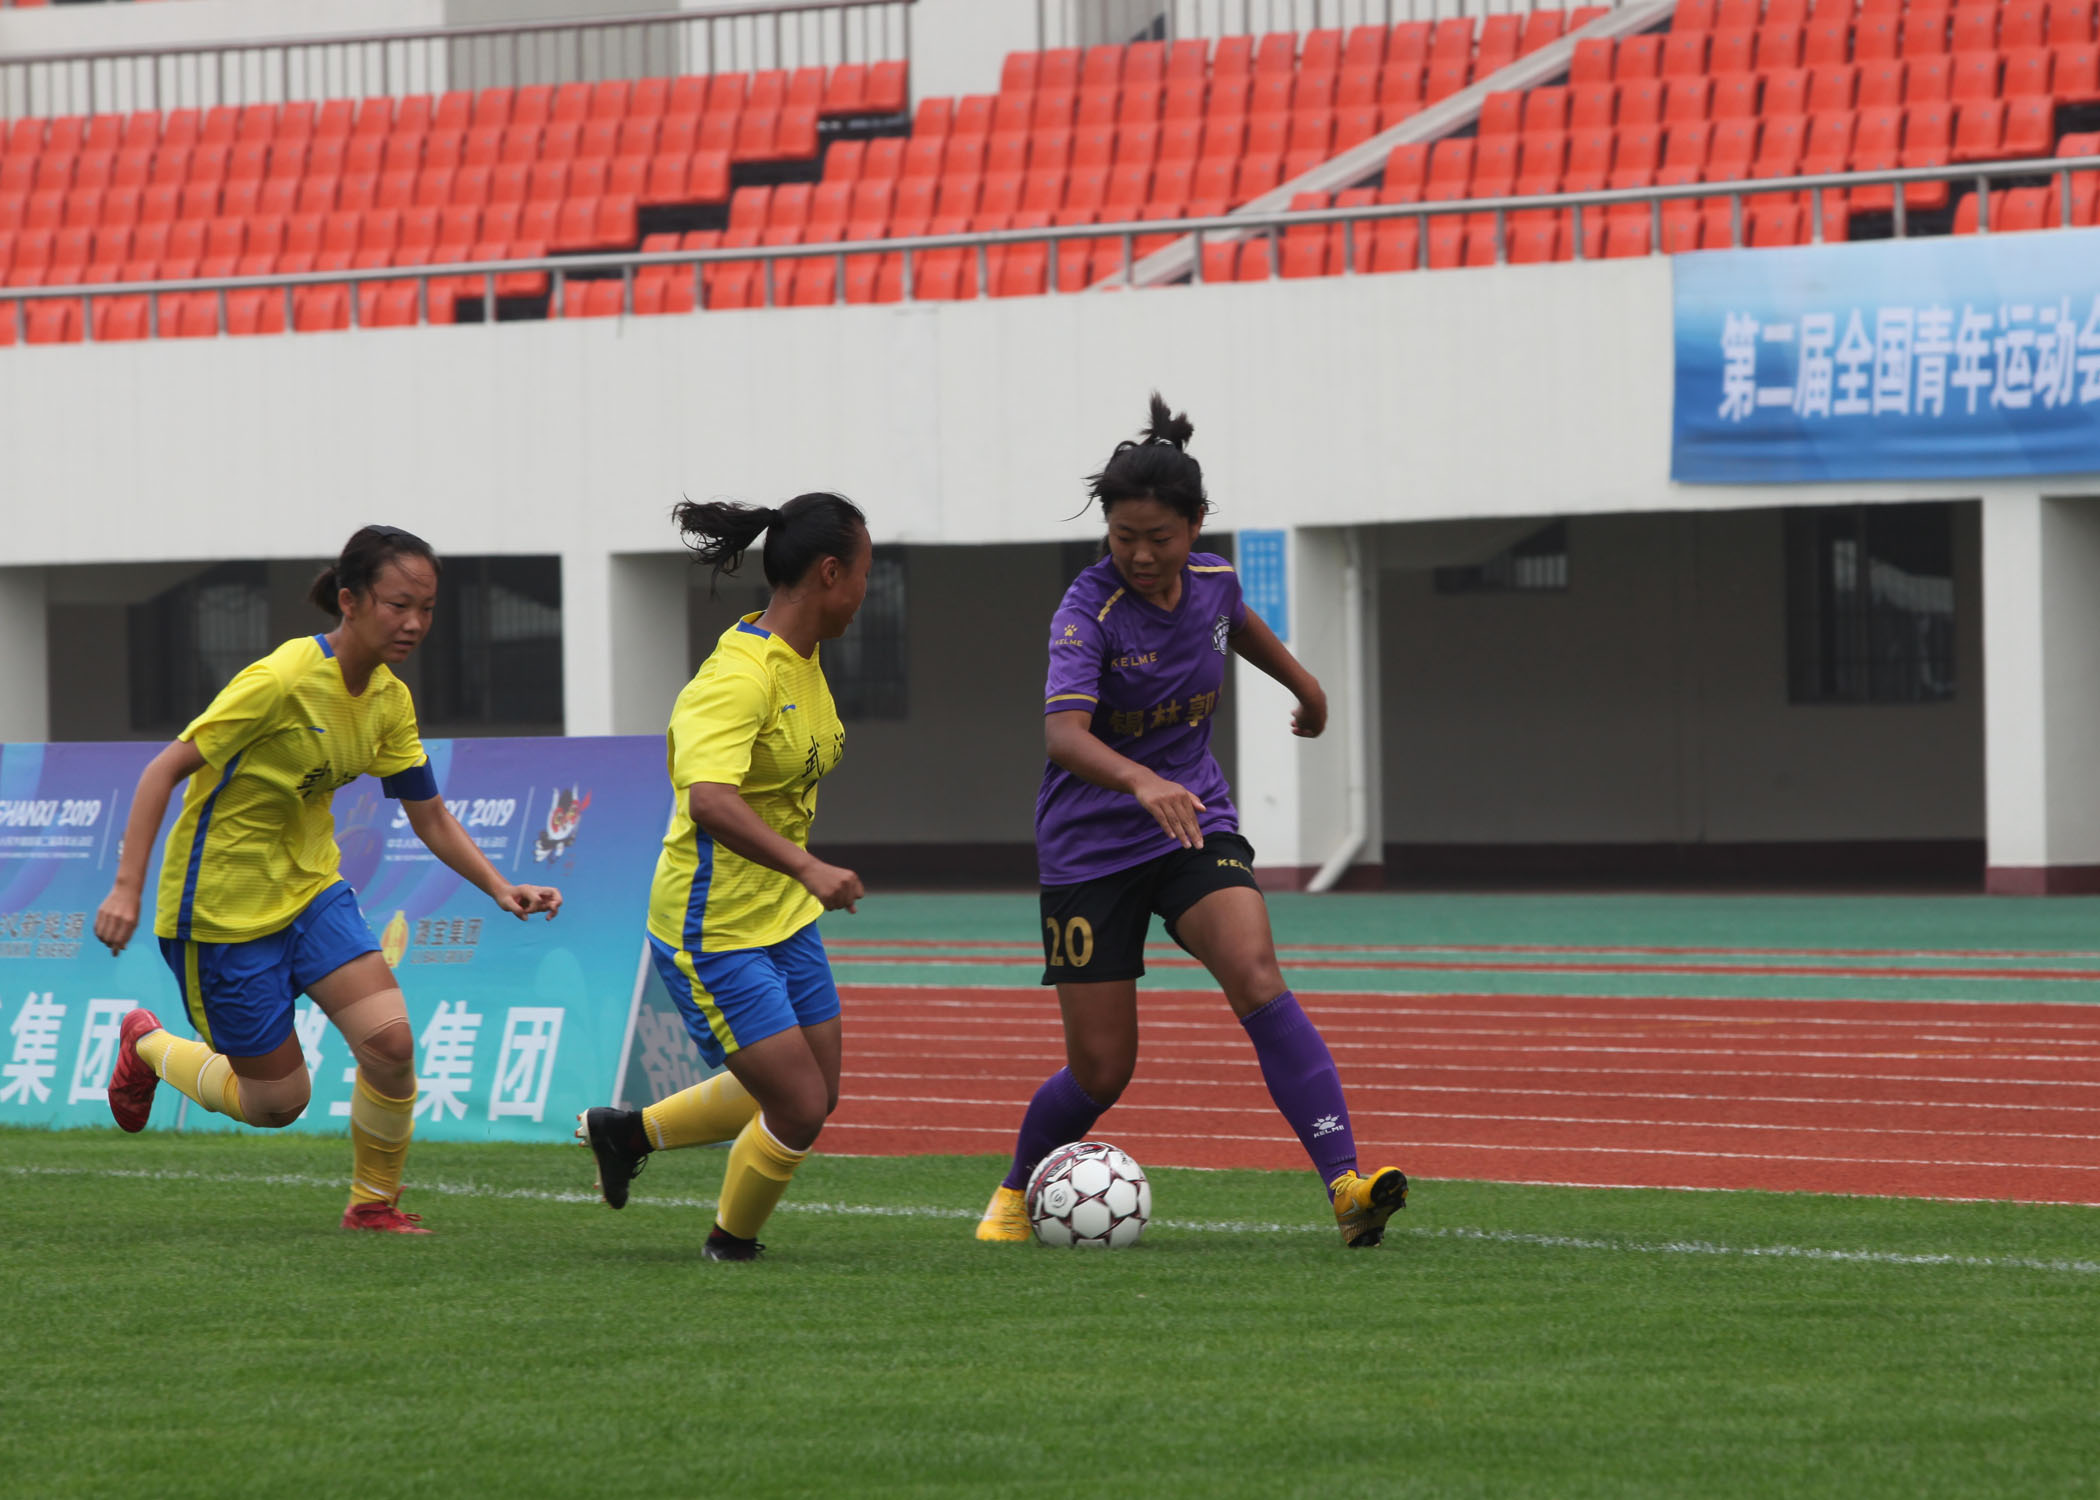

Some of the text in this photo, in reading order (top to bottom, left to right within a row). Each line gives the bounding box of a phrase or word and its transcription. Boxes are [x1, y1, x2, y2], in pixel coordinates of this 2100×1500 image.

[1055, 638, 1084, 647] KELME
[1111, 652, 1158, 667] KELME
[1109, 685, 1222, 737] 锡林郭
[57, 798, 102, 827] 2019
[467, 798, 516, 827] 2019
[1046, 916, 1094, 967] 20
[1313, 1124, 1345, 1138] KELME
